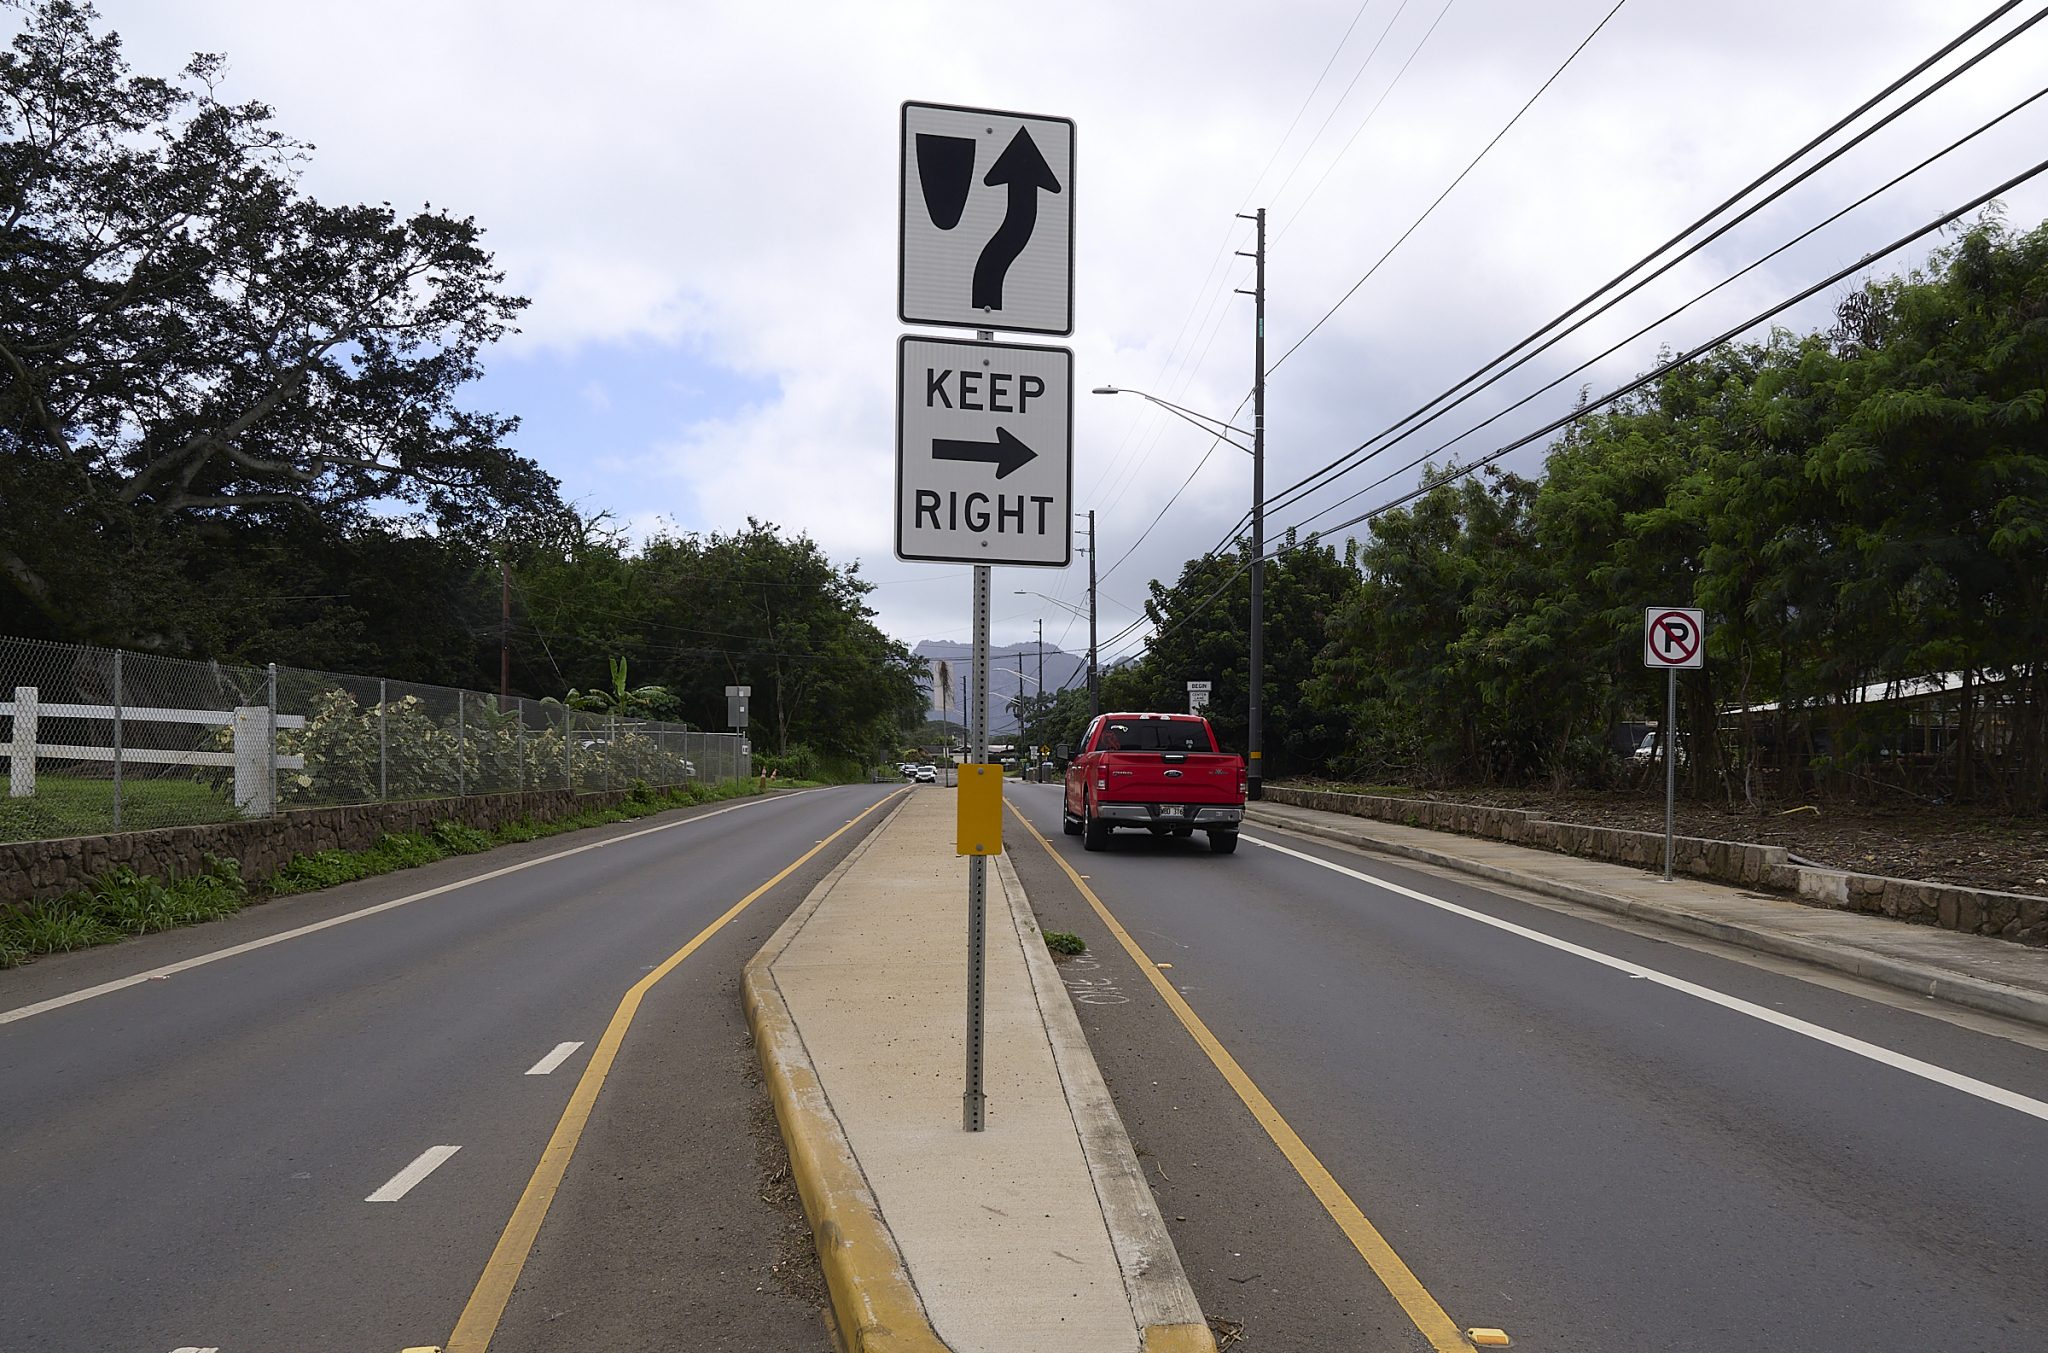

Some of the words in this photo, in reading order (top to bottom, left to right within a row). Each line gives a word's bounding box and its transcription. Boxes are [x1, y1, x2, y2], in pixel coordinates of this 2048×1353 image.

[926, 368, 1045, 414] KEEP
[915, 489, 1054, 535] RIGHT
[1664, 622, 1689, 653] P
